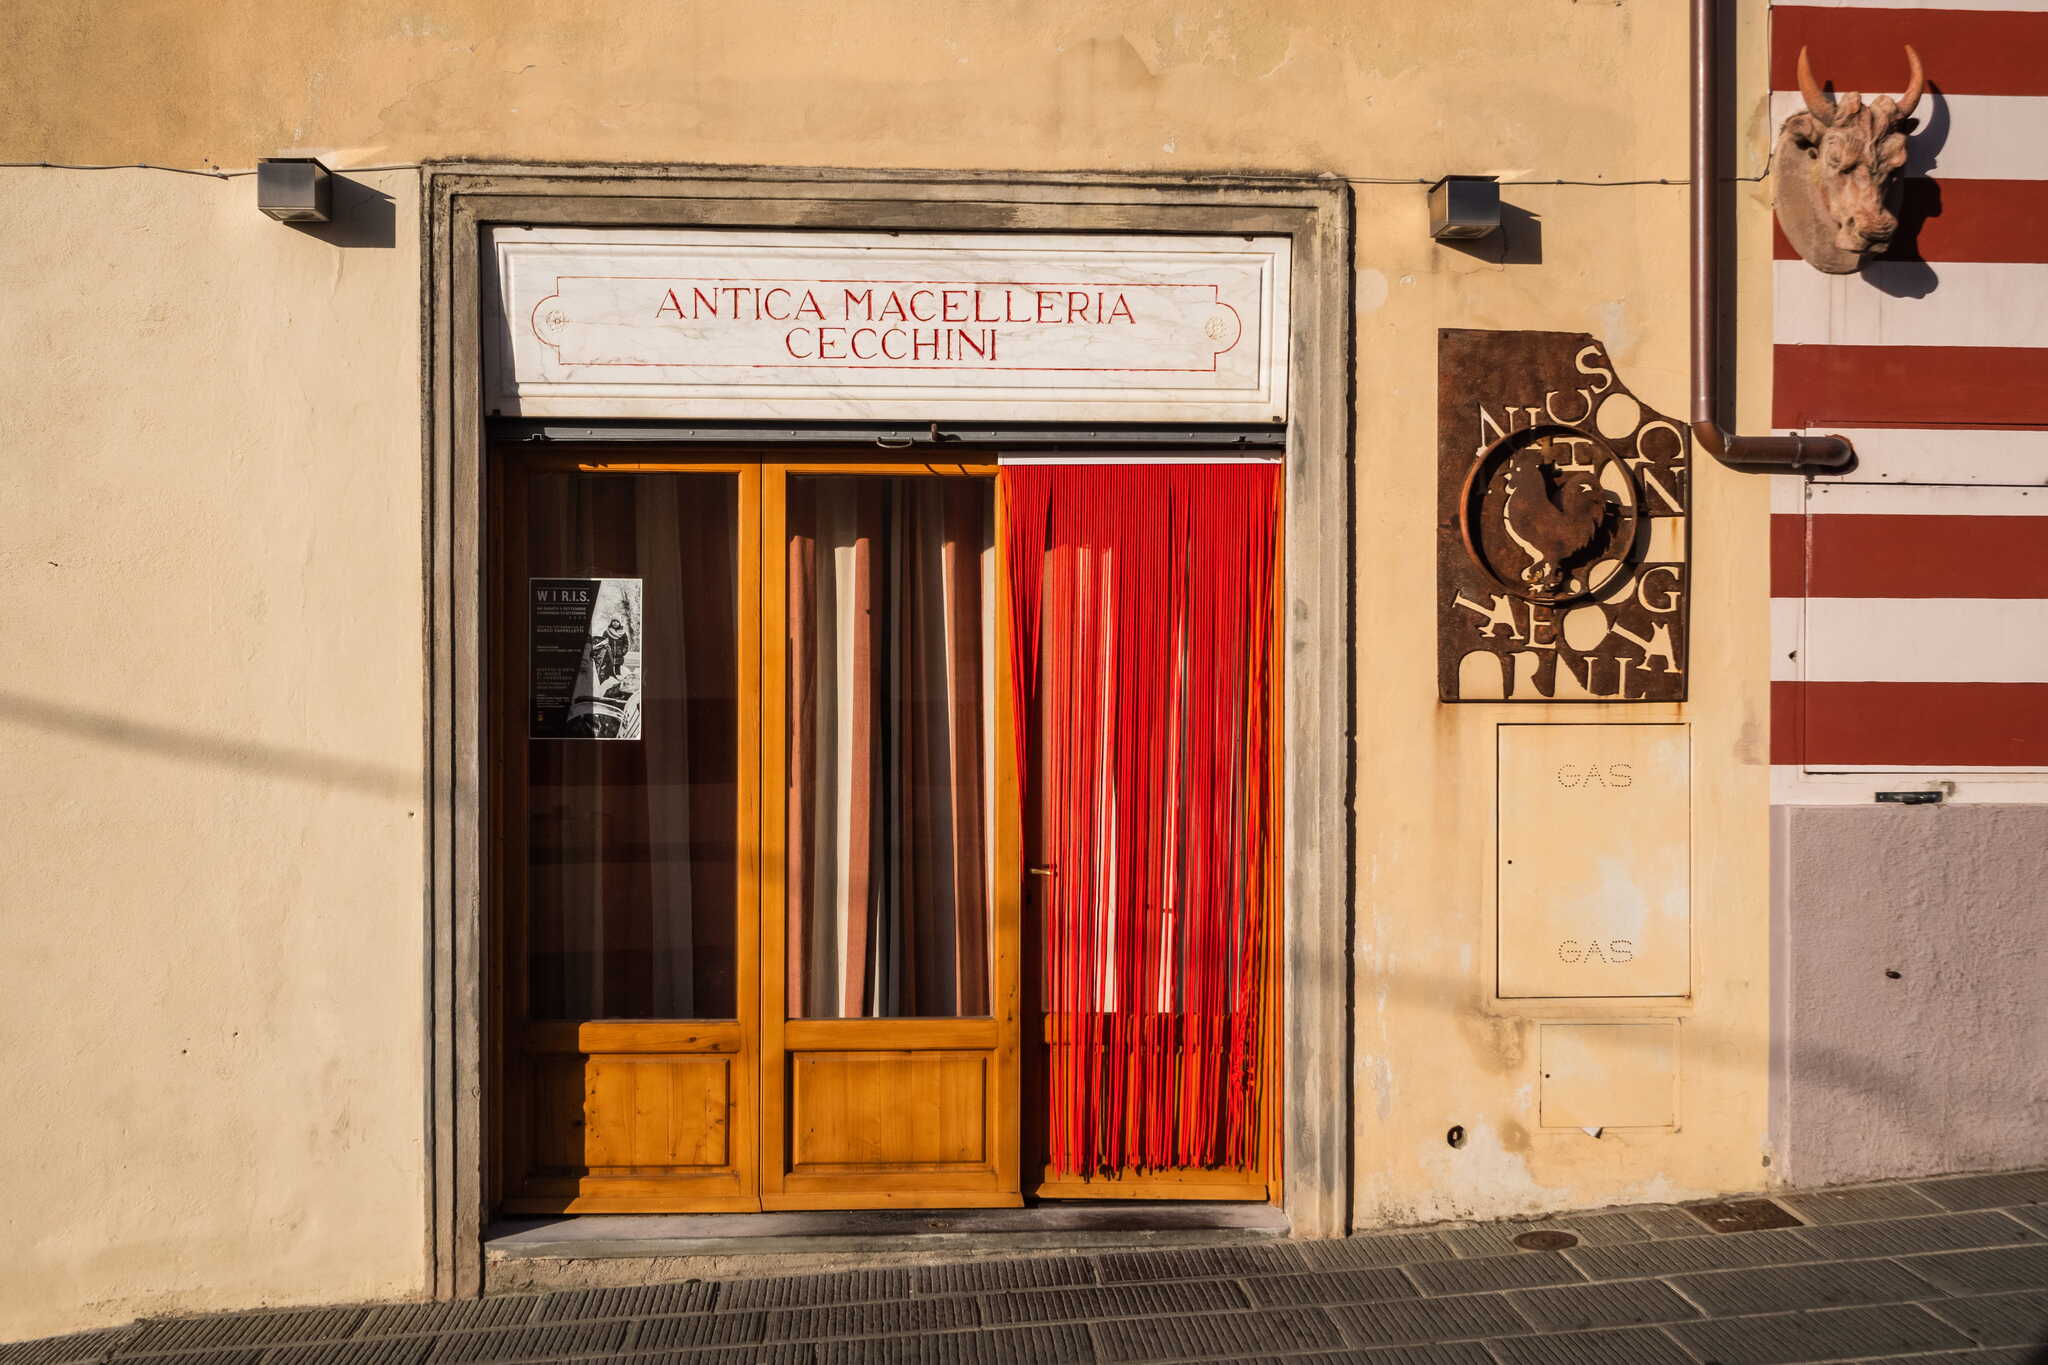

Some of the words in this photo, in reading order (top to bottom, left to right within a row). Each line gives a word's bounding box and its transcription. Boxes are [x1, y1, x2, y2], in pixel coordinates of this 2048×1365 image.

[655, 287, 825, 322] ANTICA
[843, 288, 1137, 324] MACELLERIA
[785, 327, 999, 361] CECCHINI
[1558, 763, 1632, 788] GAS
[1558, 939, 1633, 964] GAS
